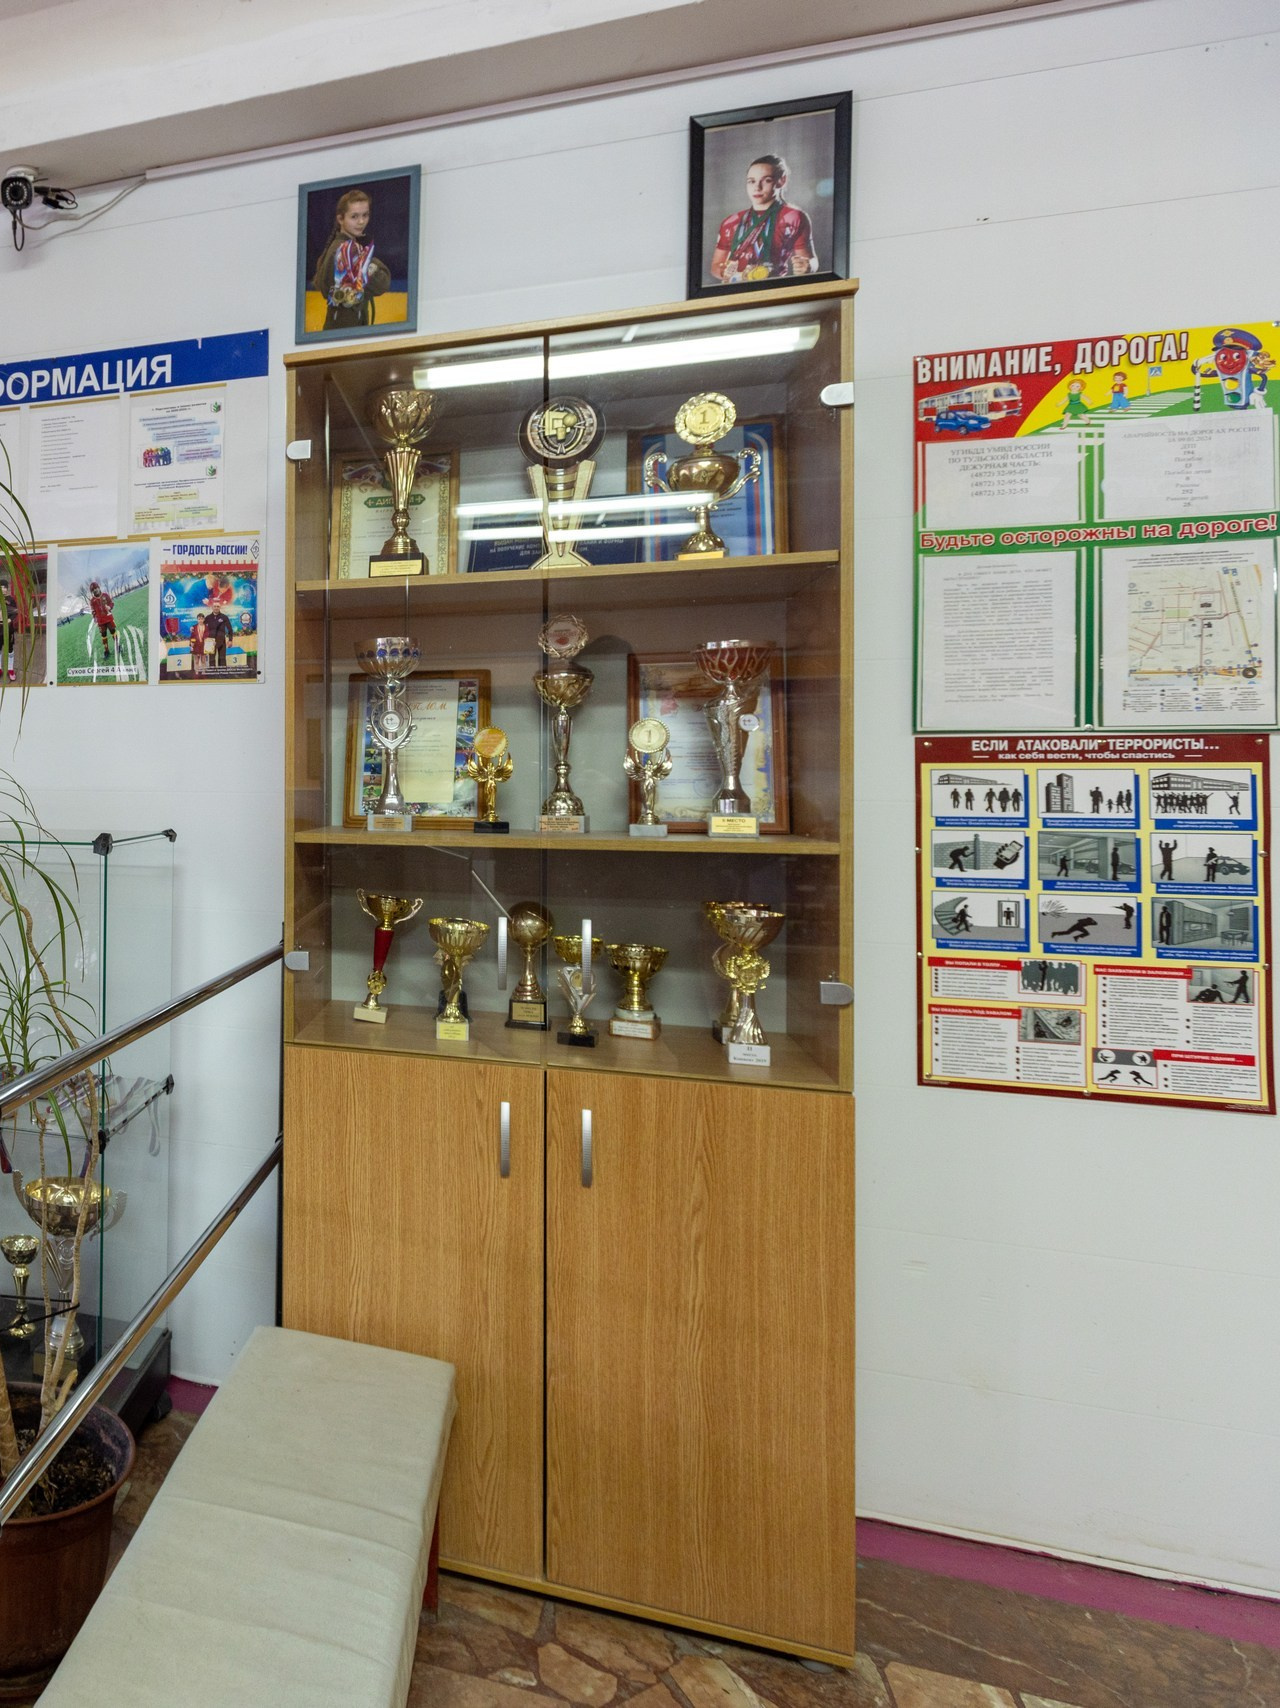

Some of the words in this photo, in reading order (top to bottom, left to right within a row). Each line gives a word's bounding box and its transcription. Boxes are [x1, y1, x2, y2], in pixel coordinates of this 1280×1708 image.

[917, 346, 1062, 384] ВНИМАНИЕ,
[1073, 332, 1189, 375] ДОРОГА!
[1015, 443, 1050, 451] РОССИИ
[963, 454, 1009, 463] ТУЛЬСКОЙ
[1011, 451, 1053, 460] ОБЛАСТИ
[960, 462, 1007, 471] ДЕЖУРНАЯ
[970, 471, 995, 479] (4872)
[970, 480, 995, 488] (4872)
[921, 533, 994, 551] Будьте
[1000, 526, 1135, 547] осторожны
[1143, 524, 1172, 538] на
[1178, 513, 1277, 539] дороге!
[173, 544, 215, 556] ГОРДОСТЬ
[216, 545, 248, 555] РОССИИ!
[972, 739, 1009, 751] ЕСЛИ
[1016, 739, 1098, 751] АТАКОВАЛИ
[1107, 738, 1220, 751] ТЕРРОРИСТЫ...
[1018, 751, 1045, 760] себя
[1085, 751, 1120, 759] чтобы
